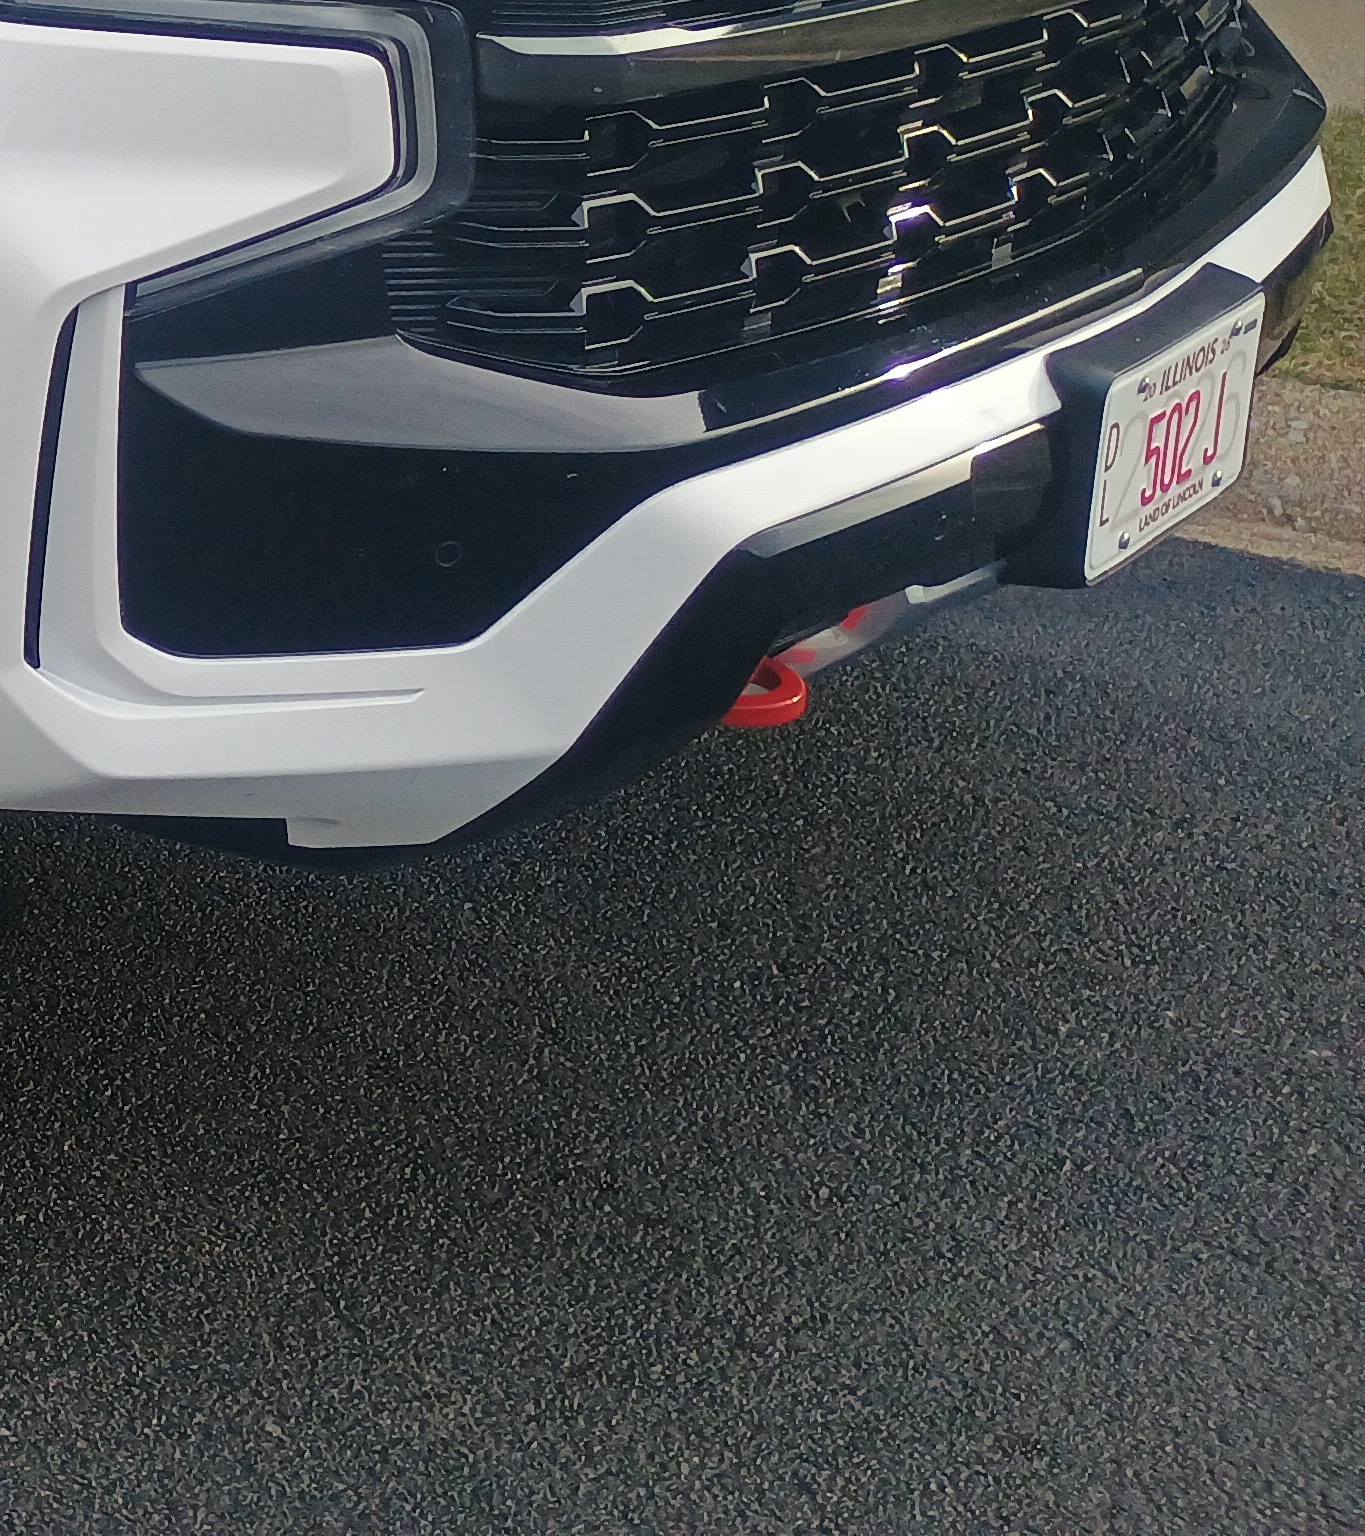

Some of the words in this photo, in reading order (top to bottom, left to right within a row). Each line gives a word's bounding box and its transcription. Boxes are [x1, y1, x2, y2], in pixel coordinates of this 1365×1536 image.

[1158, 337, 1220, 396] ILLINOIS
[1140, 389, 1201, 507] 502
[1202, 370, 1228, 466] J
